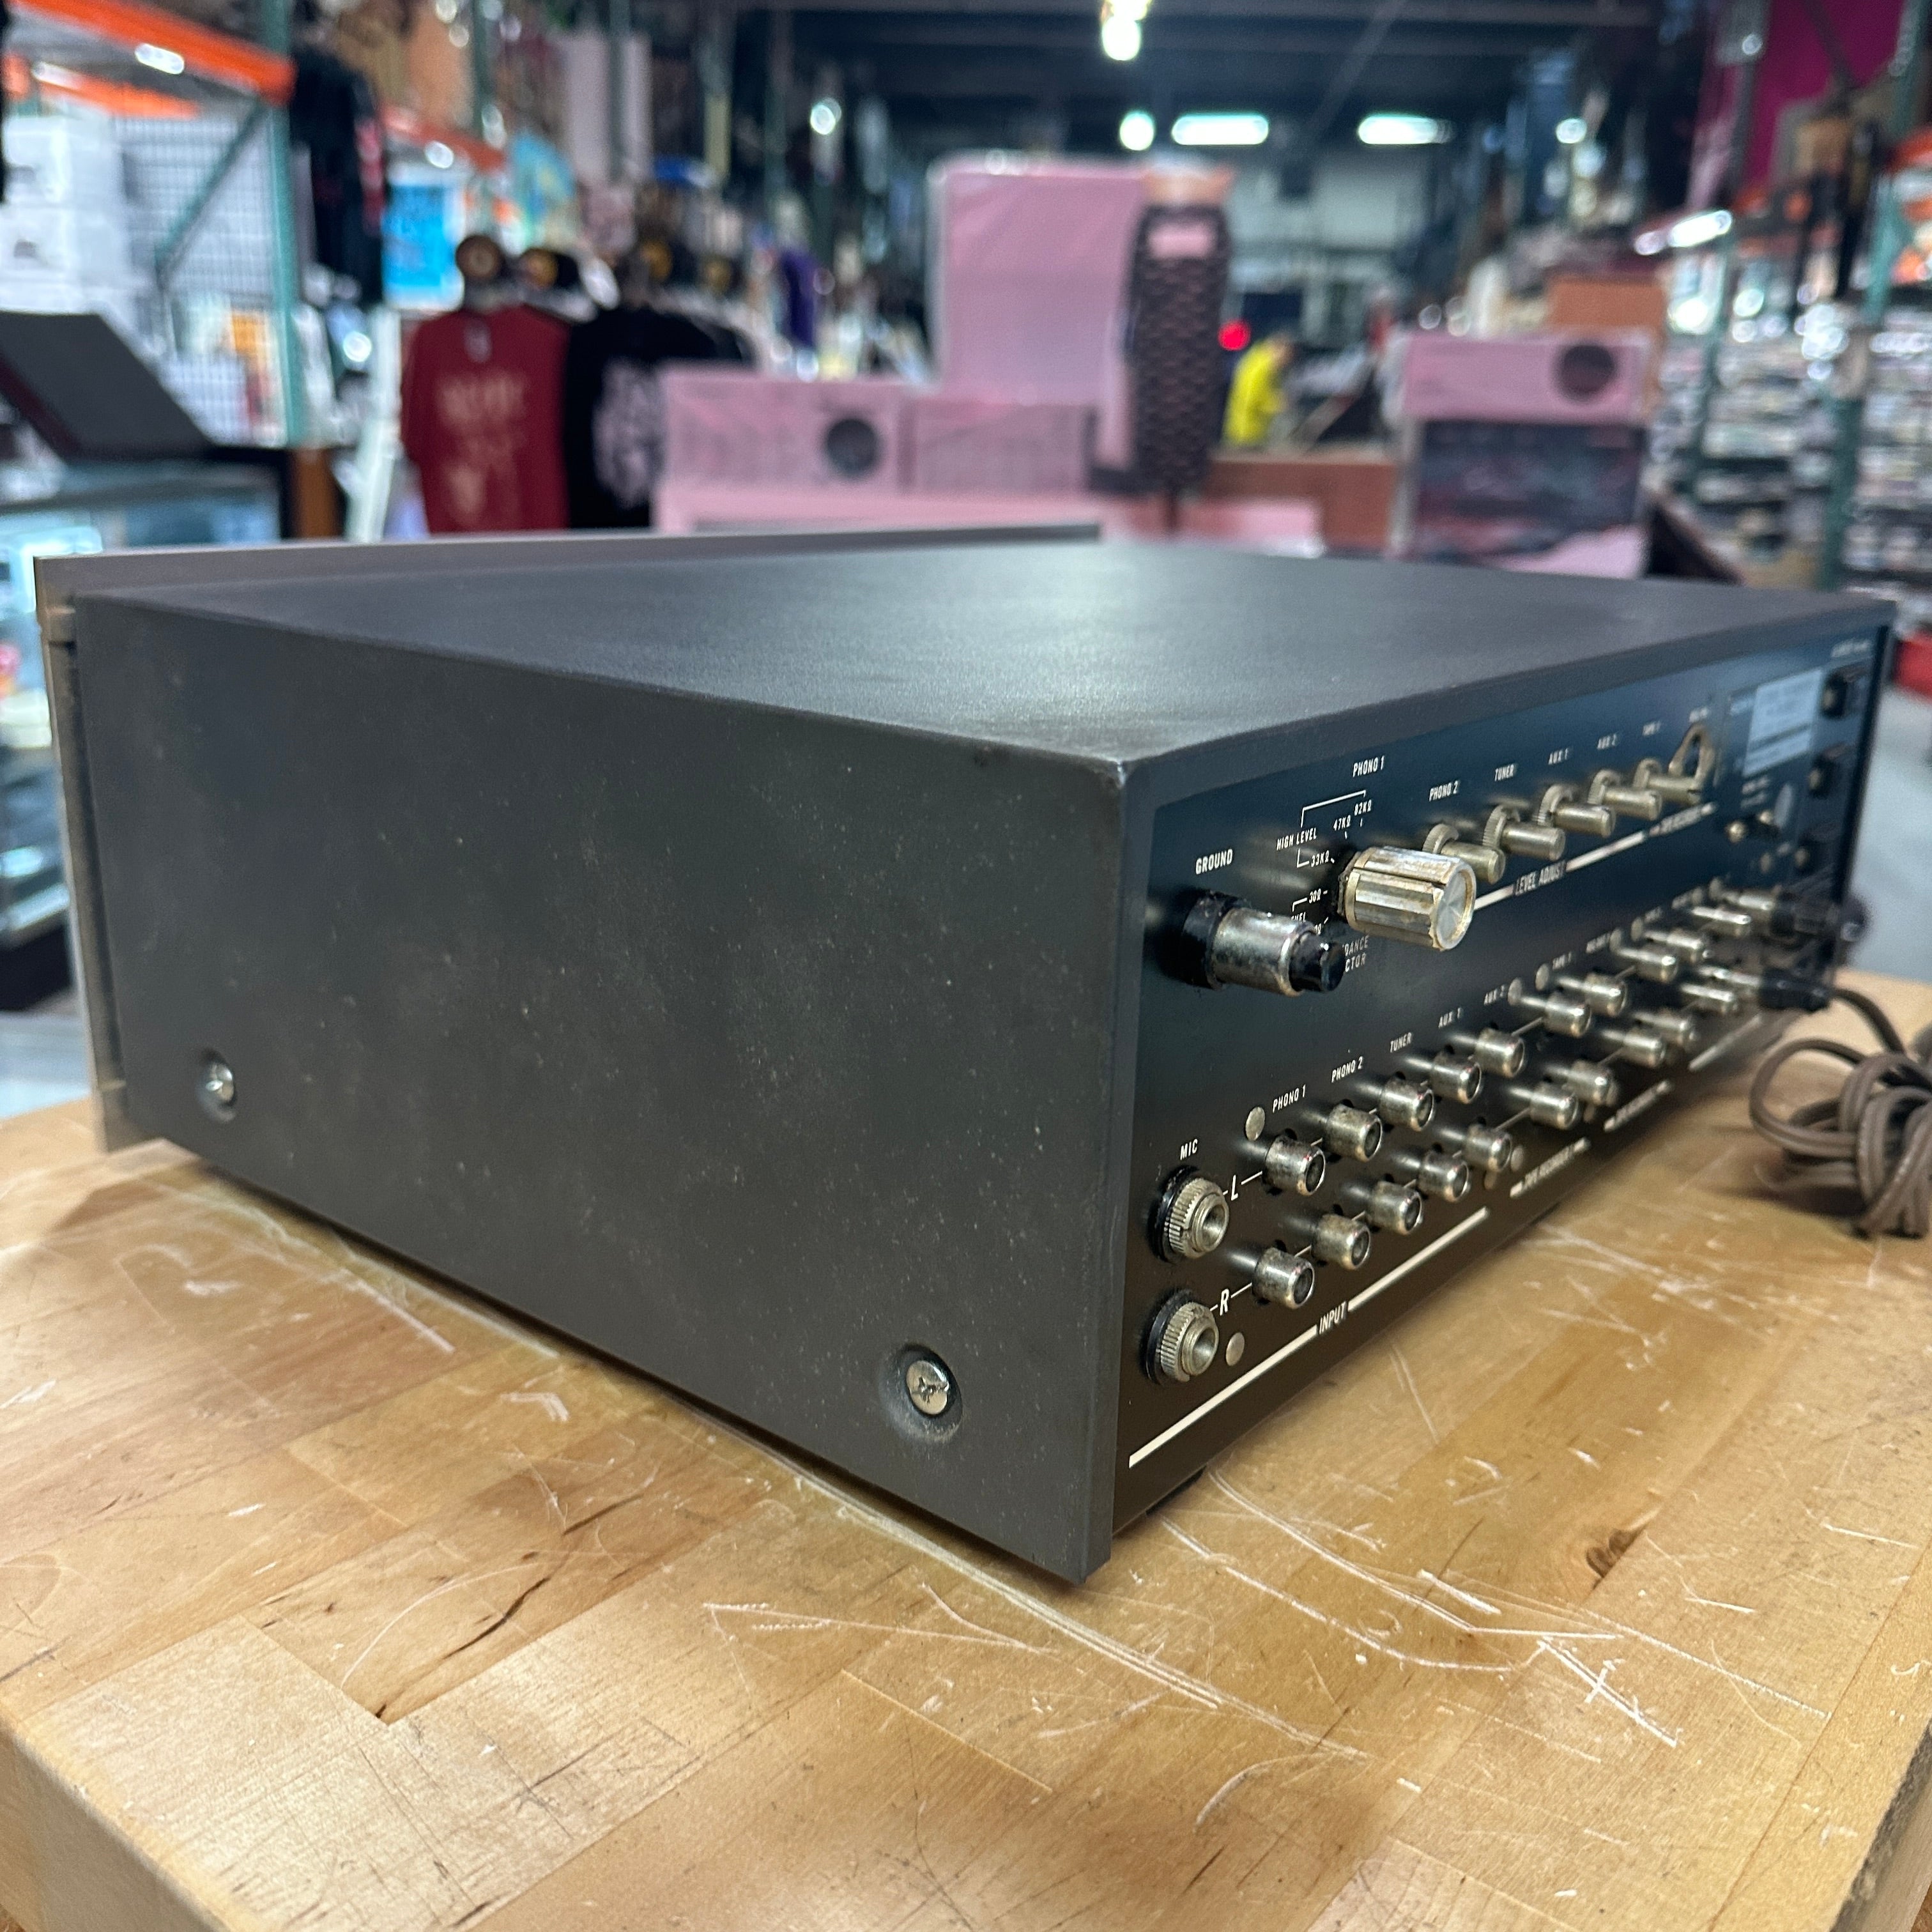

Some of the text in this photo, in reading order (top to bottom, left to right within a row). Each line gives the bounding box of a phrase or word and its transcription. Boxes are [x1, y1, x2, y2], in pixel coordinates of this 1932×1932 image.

[1352, 755, 1384, 778] PHONO 1
[1548, 751, 1563, 765] AUX
[1494, 763, 1516, 782] TUNER
[1429, 779, 1460, 802] PHONO 2
[1276, 827, 1317, 851] HIGH LEVEL
[1195, 848, 1233, 875] GROUND
[1515, 870, 1537, 896] LEVEL
[1342, 935, 1370, 957] DANCE
[1438, 1007, 1462, 1029] AUX 1
[1390, 1032, 1413, 1054] TUNER
[1331, 1056, 1364, 1084] PHONO 2
[1272, 1084, 1307, 1114] PHONO 1
[1180, 1138, 1198, 1160] MIC
[1230, 1174, 1239, 1201] L
[1220, 1288, 1230, 1316] R
[1319, 1300, 1347, 1335] INPUT
